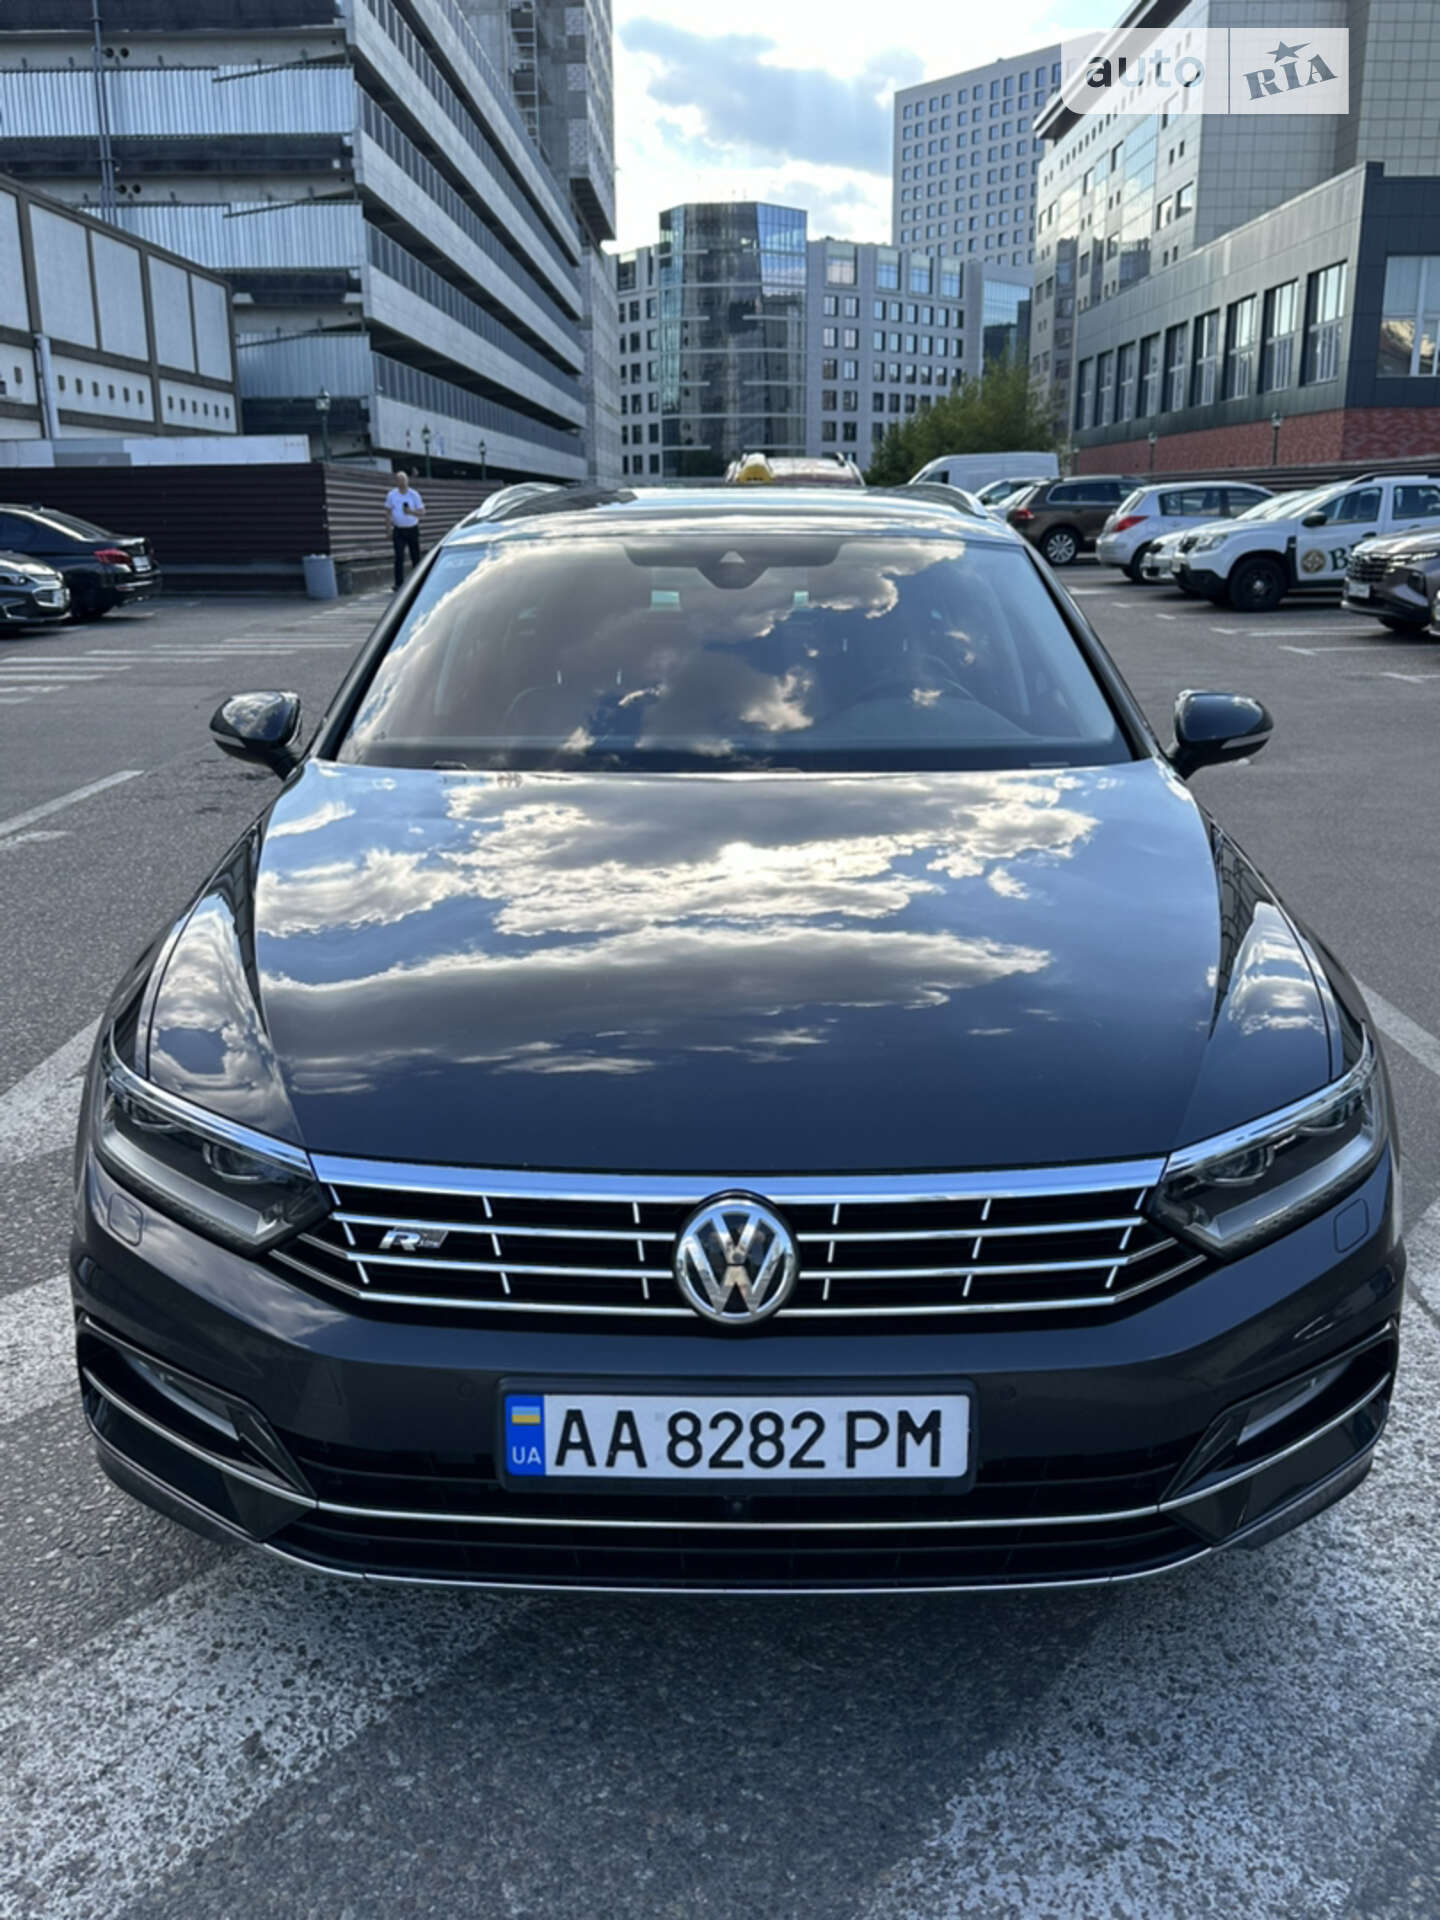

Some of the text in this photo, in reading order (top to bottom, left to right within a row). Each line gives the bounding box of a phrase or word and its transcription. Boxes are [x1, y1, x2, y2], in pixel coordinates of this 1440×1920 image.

[512, 1447, 542, 1465] UA
[555, 1409, 941, 1469] AA 8282 PM
